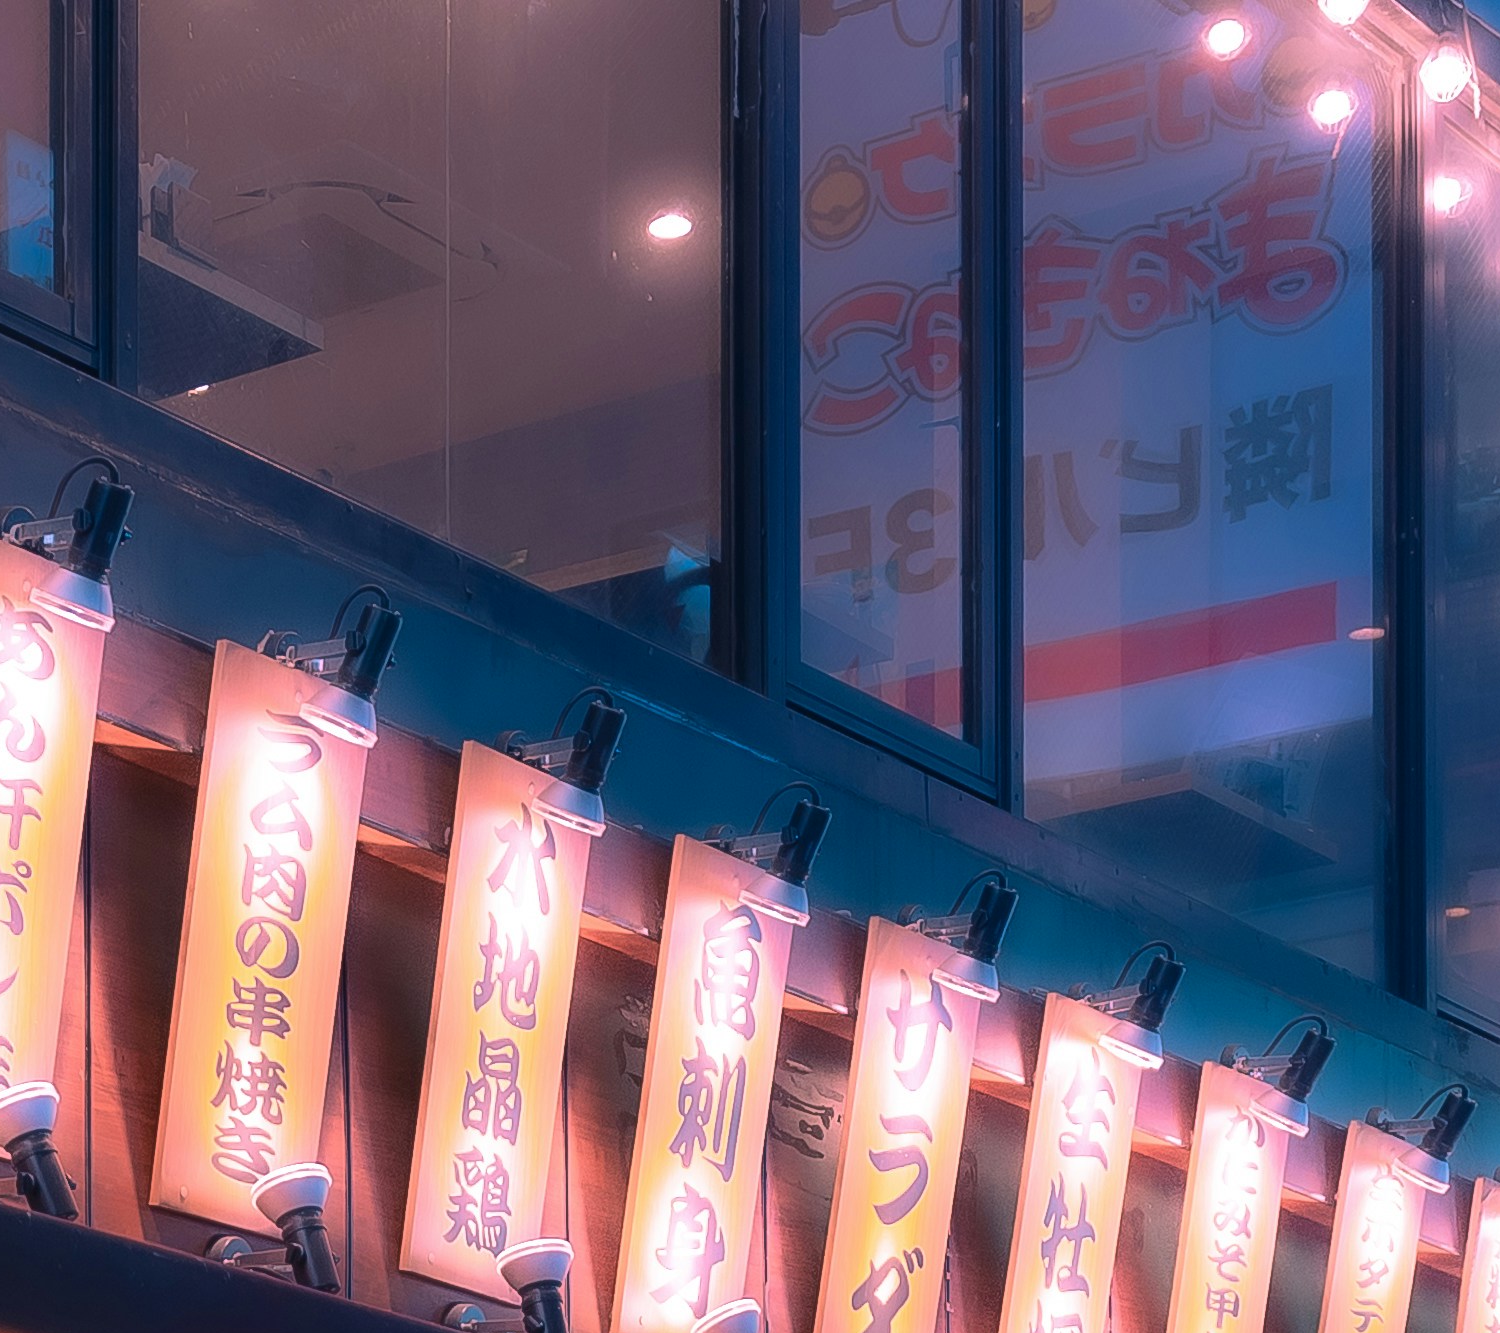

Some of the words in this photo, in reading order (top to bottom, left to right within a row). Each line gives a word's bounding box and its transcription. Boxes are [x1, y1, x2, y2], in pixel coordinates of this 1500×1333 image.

[210, 708, 323, 1186] ラム肉の串焼き
